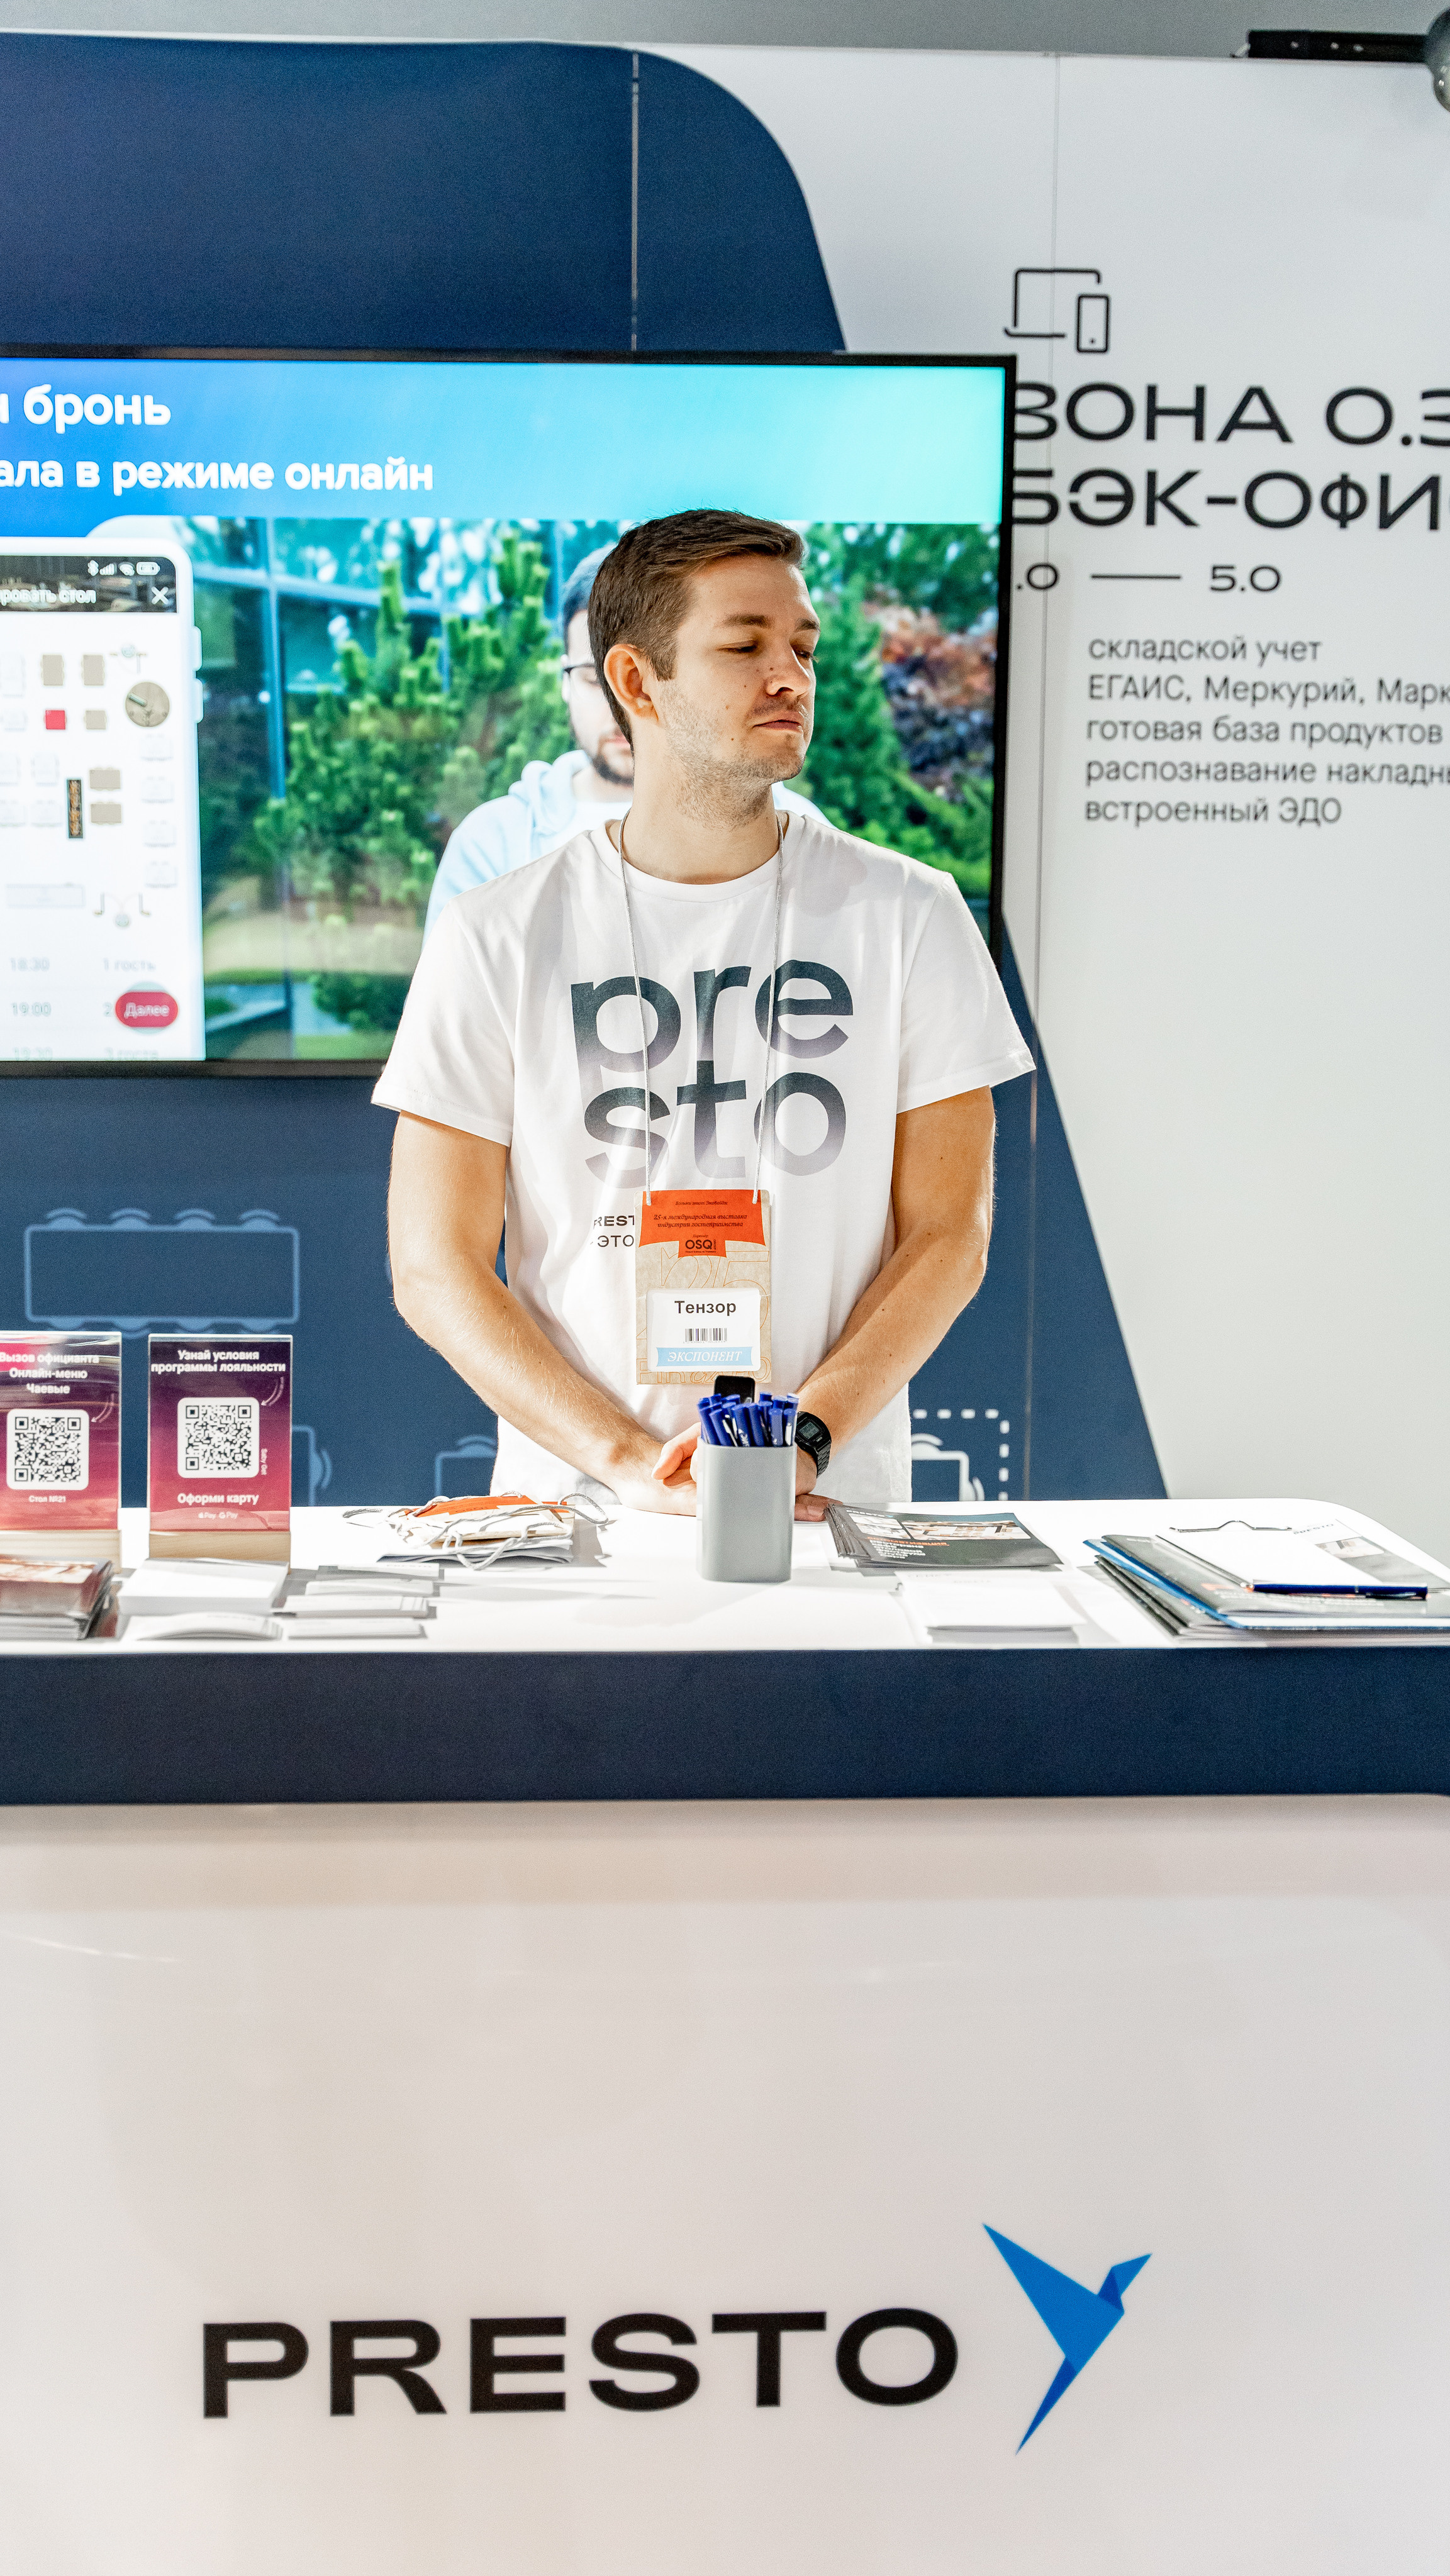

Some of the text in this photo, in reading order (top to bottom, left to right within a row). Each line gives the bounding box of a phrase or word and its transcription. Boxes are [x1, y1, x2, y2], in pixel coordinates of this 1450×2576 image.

[23, 384, 171, 434] бронь
[76, 461, 99, 487] в
[113, 461, 274, 495] режиме
[284, 457, 433, 491] онлайн
[1012, 469, 1450, 530] БЭК-ОФИ
[1016, 563, 1281, 591] .0 5.0
[1089, 635, 1322, 667] складской учет
[1089, 674, 1191, 703] ЕГАИС,
[1205, 677, 1366, 708] Меркурий,
[1086, 715, 1442, 749] готовая база продуктов
[1086, 760, 1317, 786] распознавание
[1085, 796, 1341, 828] встроенный ЭДО
[12, 1002, 52, 1017] 19:00
[124, 1002, 170, 1019] Далее
[571, 959, 854, 1113] pre
[584, 1060, 846, 1189] sto
[598, 1235, 634, 1247] ЭТО
[685, 1240, 712, 1250] OSQ
[674, 1301, 736, 1316] Тензор
[151, 1362, 286, 1373] программы лояльности
[178, 1349, 259, 1362] Узнай условия
[667, 1351, 742, 1362] ЭКСПОНЕНТ
[9, 1368, 87, 1379] Онлайн-меню
[26, 1383, 70, 1394] Чаевые
[177, 1493, 259, 1505] Оформи карту
[202, 2308, 959, 2419] PRESTO
